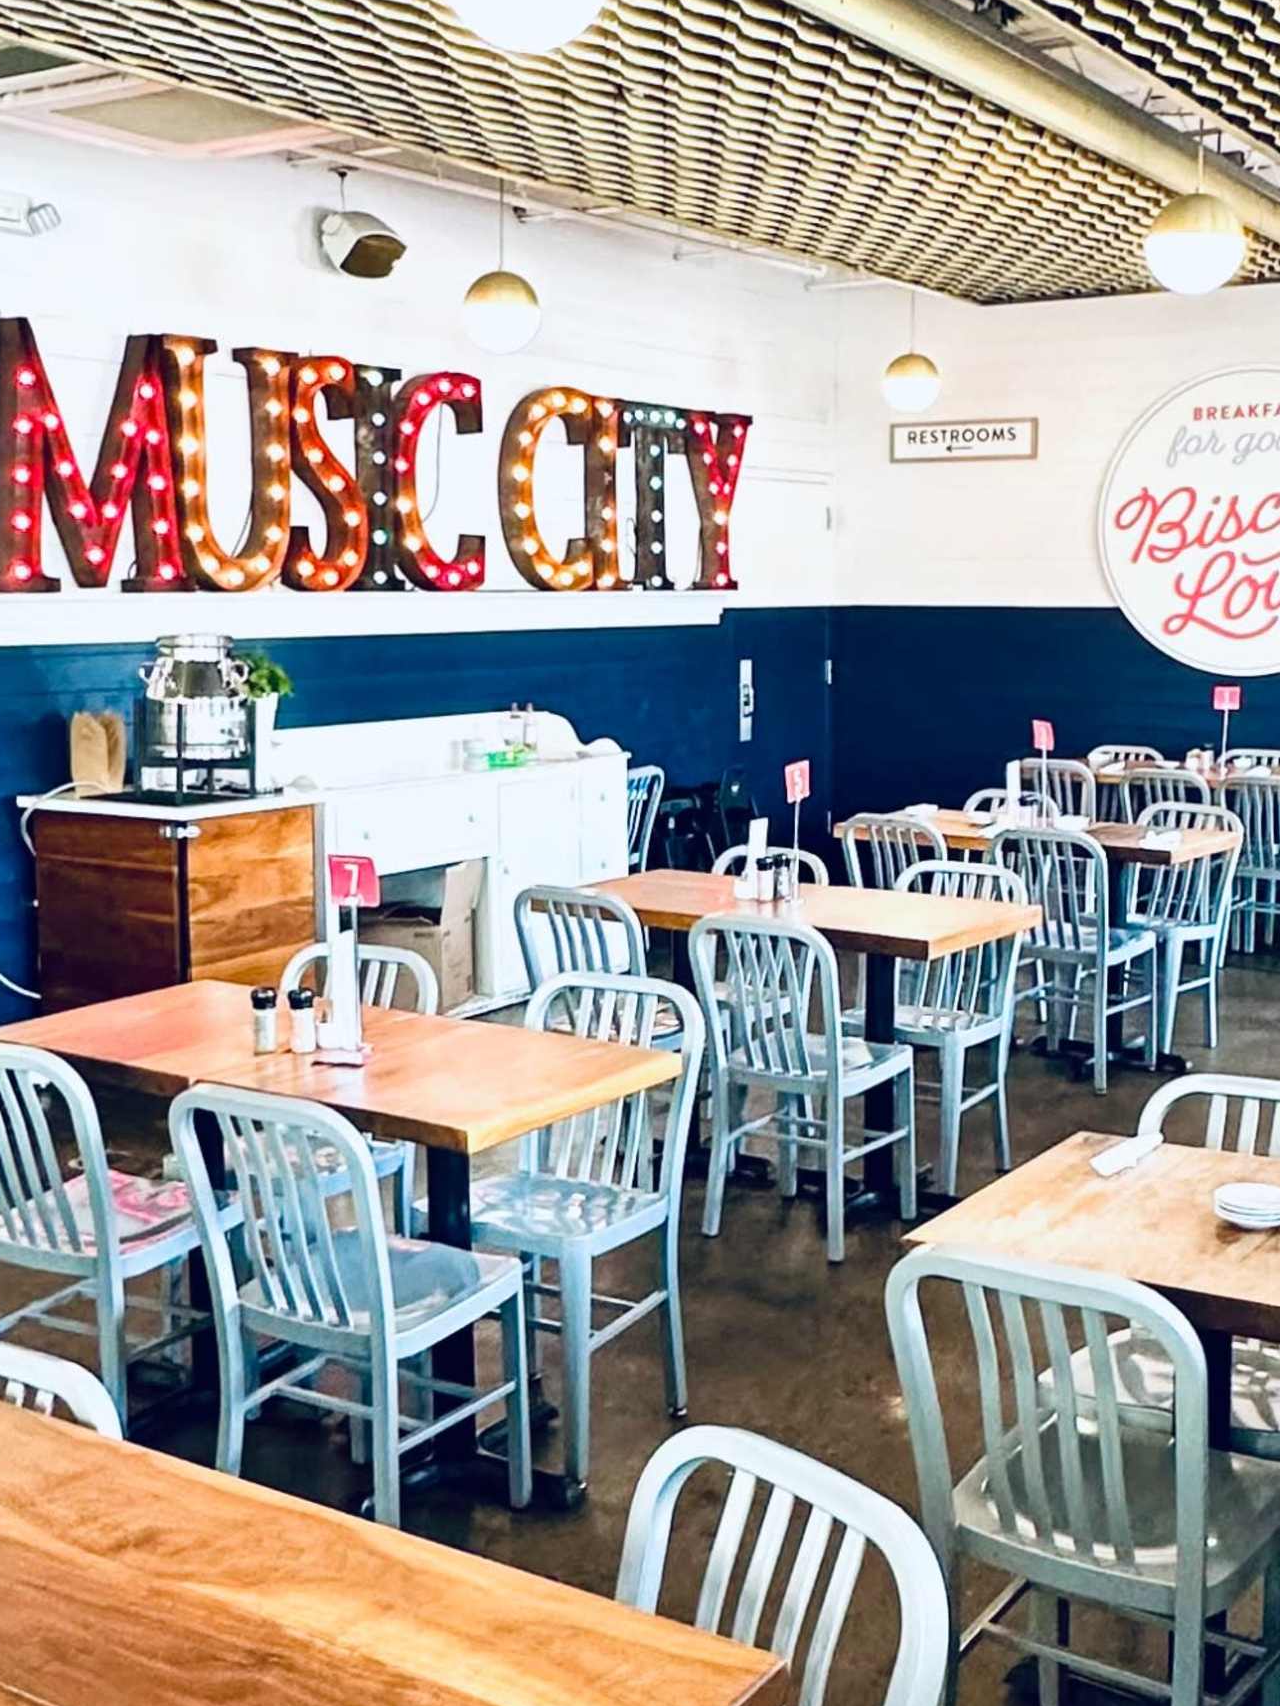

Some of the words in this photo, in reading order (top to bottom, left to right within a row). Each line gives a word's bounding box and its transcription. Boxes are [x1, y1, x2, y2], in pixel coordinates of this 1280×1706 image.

[906, 426, 1017, 445] RESTROOMS
[1165, 424, 1226, 468] for
[498, 385, 754, 592] CITY
[343, 864, 360, 896] 7
